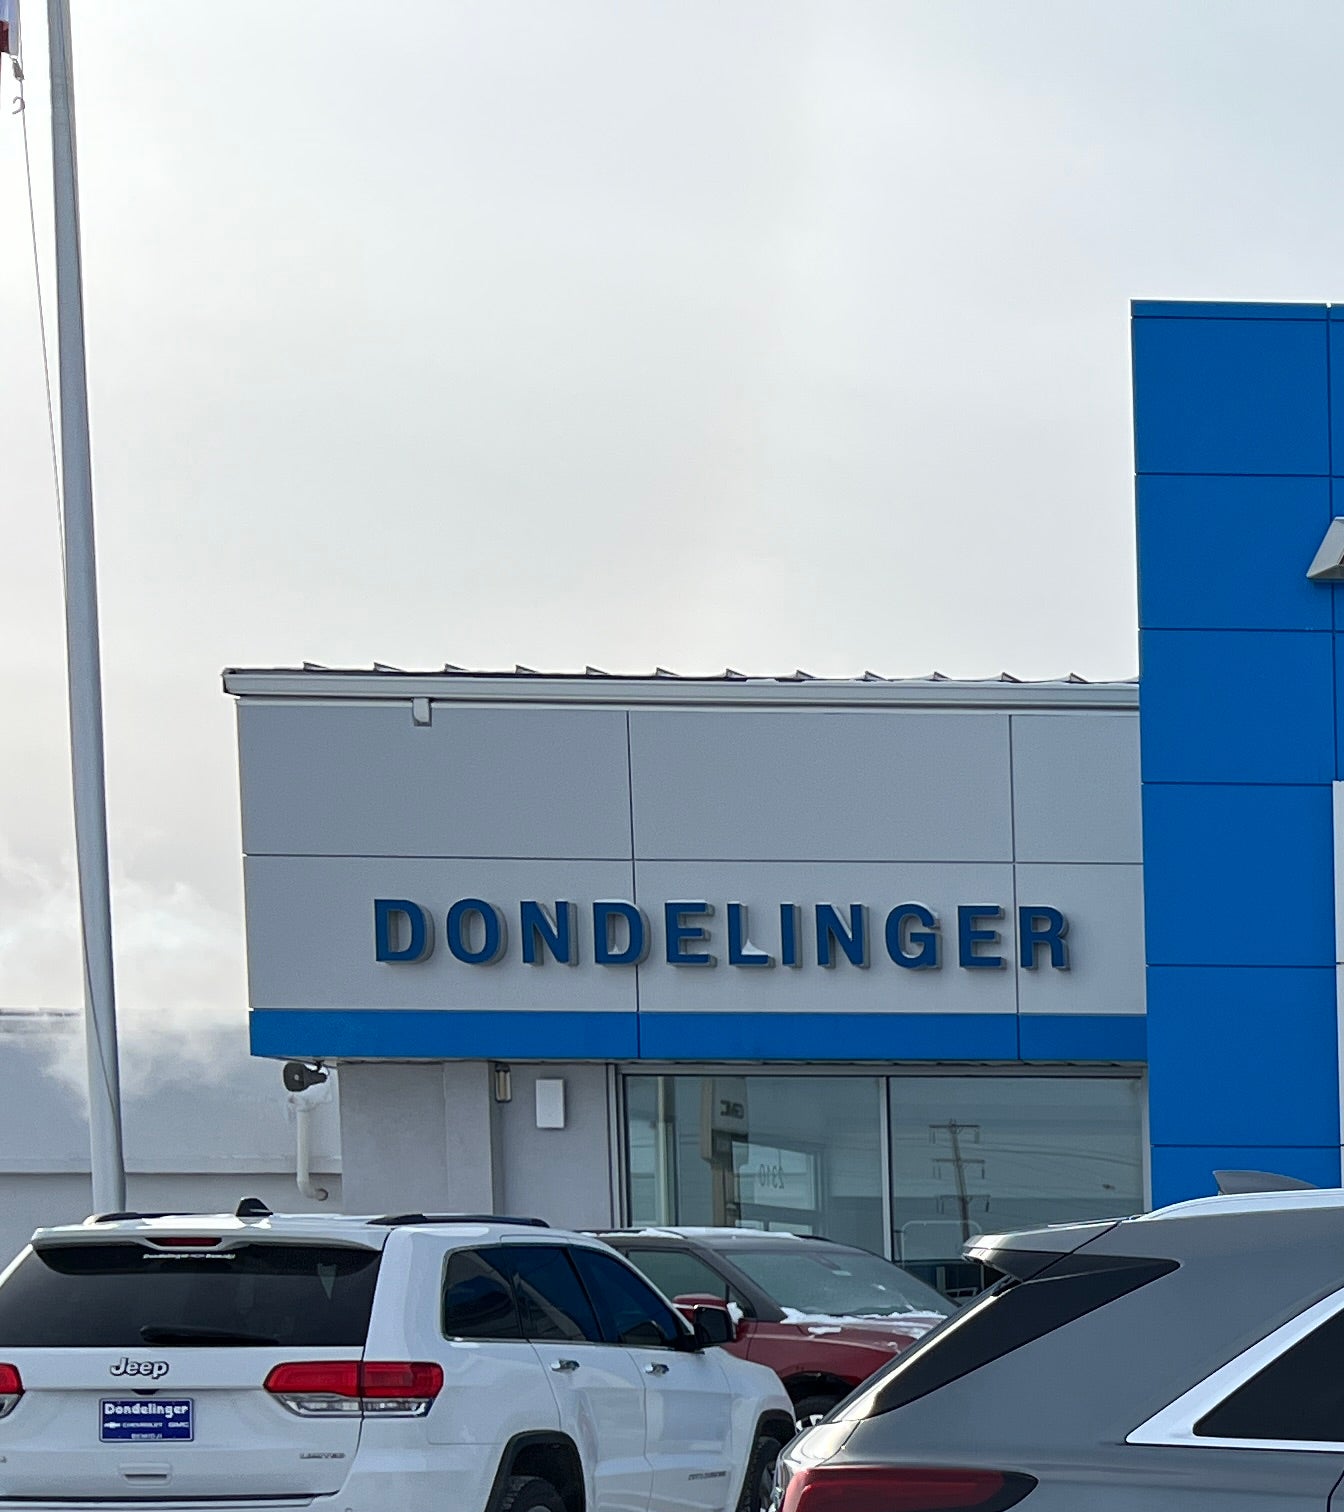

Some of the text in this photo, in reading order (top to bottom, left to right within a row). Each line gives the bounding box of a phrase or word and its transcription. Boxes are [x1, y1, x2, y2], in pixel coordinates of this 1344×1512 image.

[374, 898, 1073, 970] DONDELINGER
[110, 1357, 169, 1380] Jeep
[104, 1403, 189, 1419] Dondelinger
